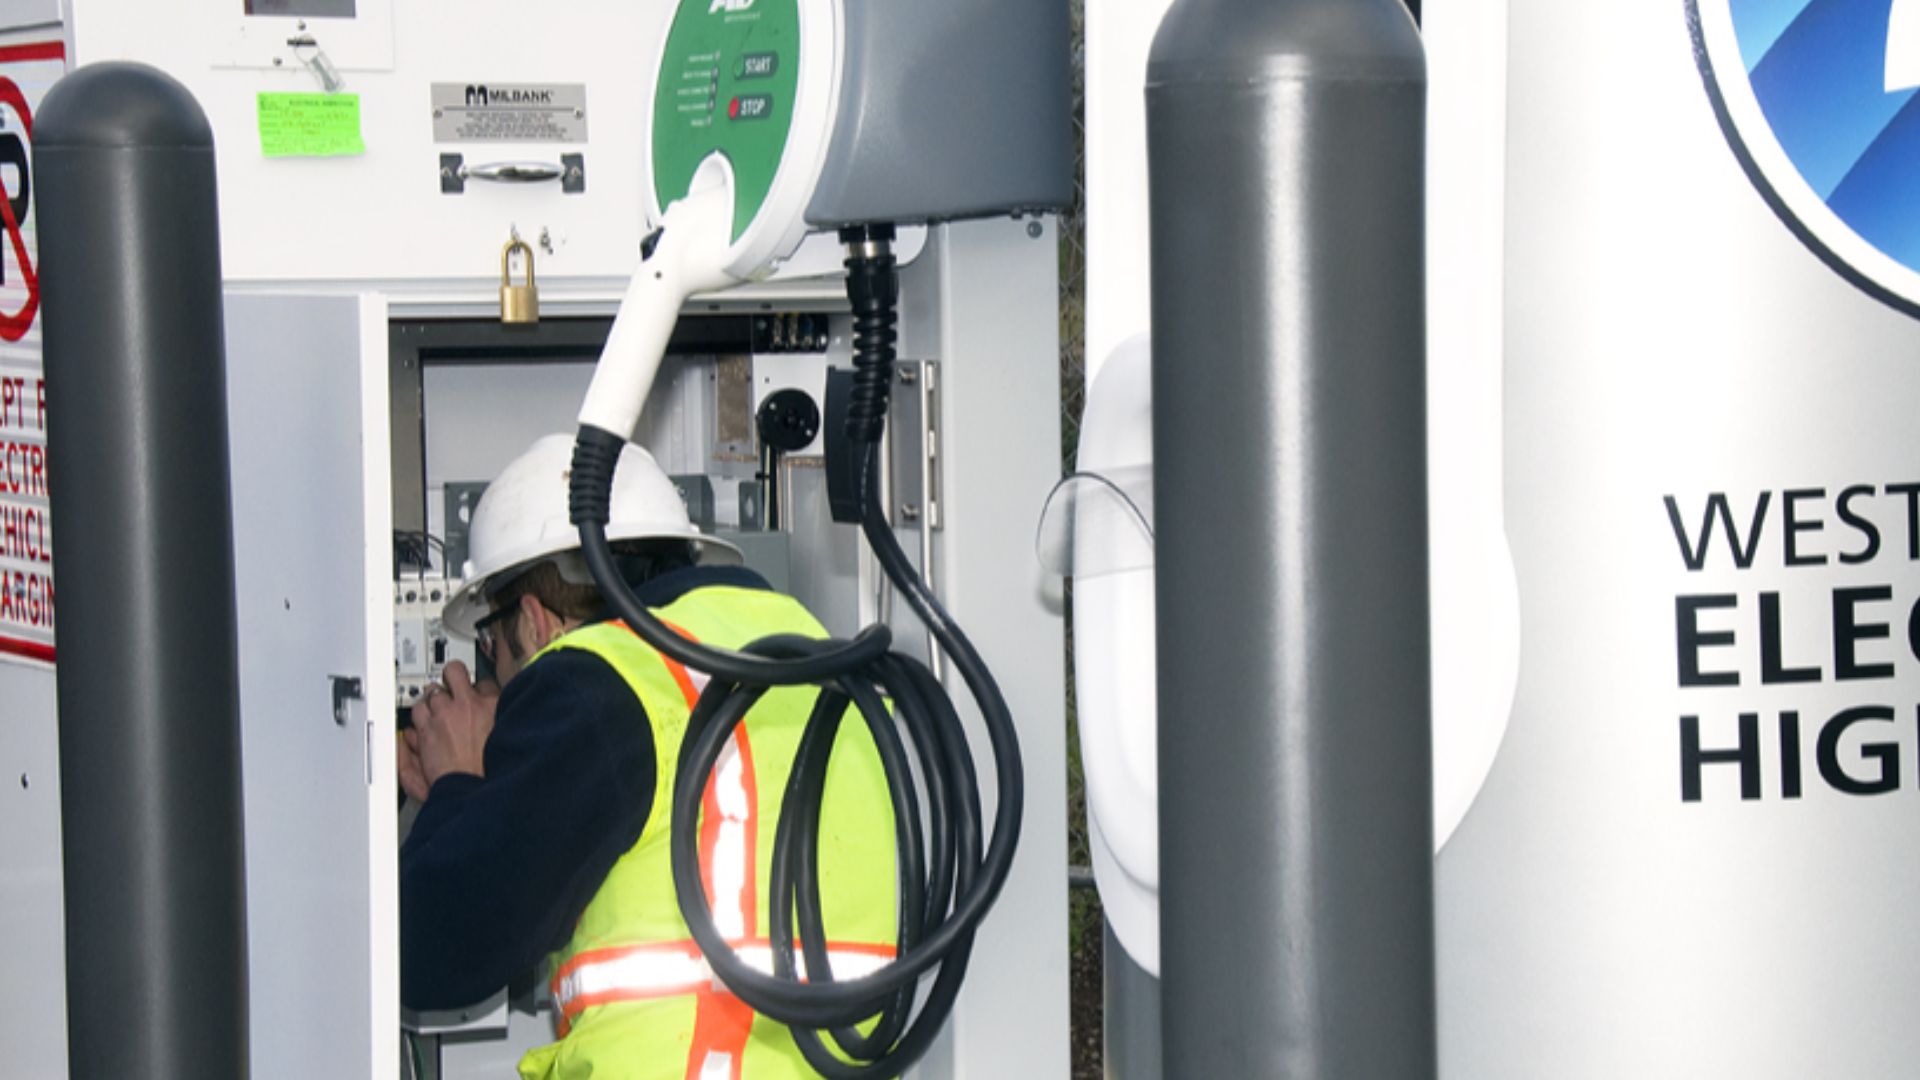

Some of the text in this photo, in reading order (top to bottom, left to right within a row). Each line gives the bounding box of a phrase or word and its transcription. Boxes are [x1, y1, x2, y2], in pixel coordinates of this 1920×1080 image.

[740, 98, 765, 116] STOP
[745, 56, 771, 75] START
[1663, 482, 1920, 572] WEST
[1675, 584, 1920, 688] ELE
[1679, 703, 1920, 803] HIG
